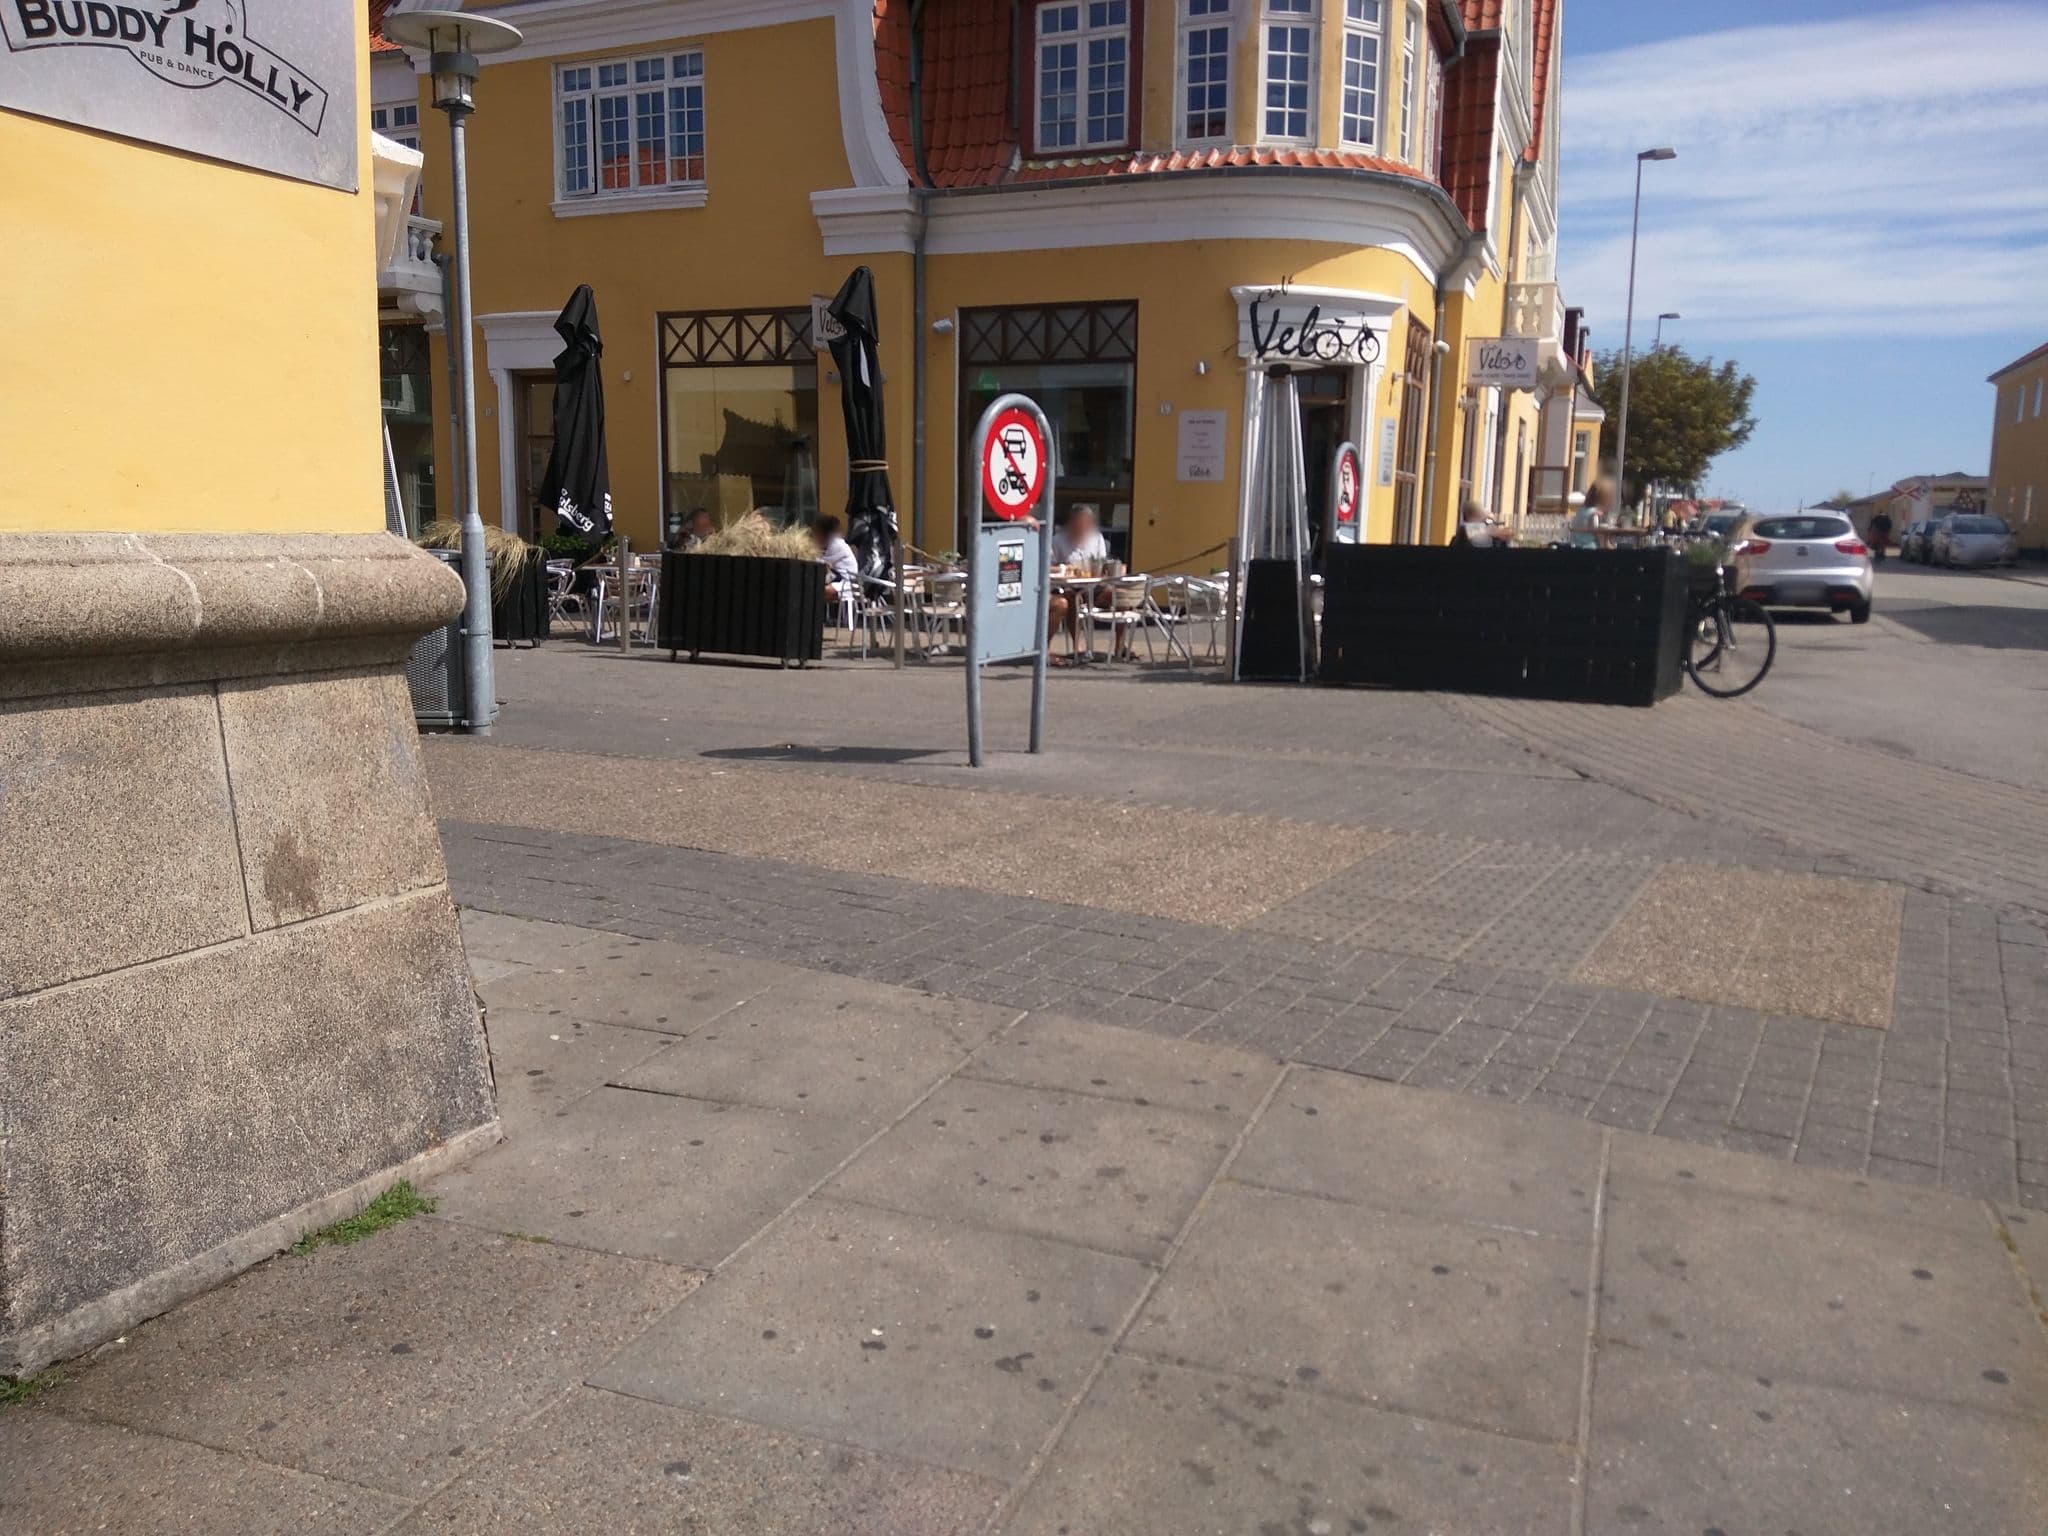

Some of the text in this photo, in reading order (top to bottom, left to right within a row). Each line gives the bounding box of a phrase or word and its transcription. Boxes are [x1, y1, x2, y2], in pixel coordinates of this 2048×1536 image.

[17, 0, 313, 114] BUDDY HOLLY
[140, 51, 214, 80] PUB & DANCE
